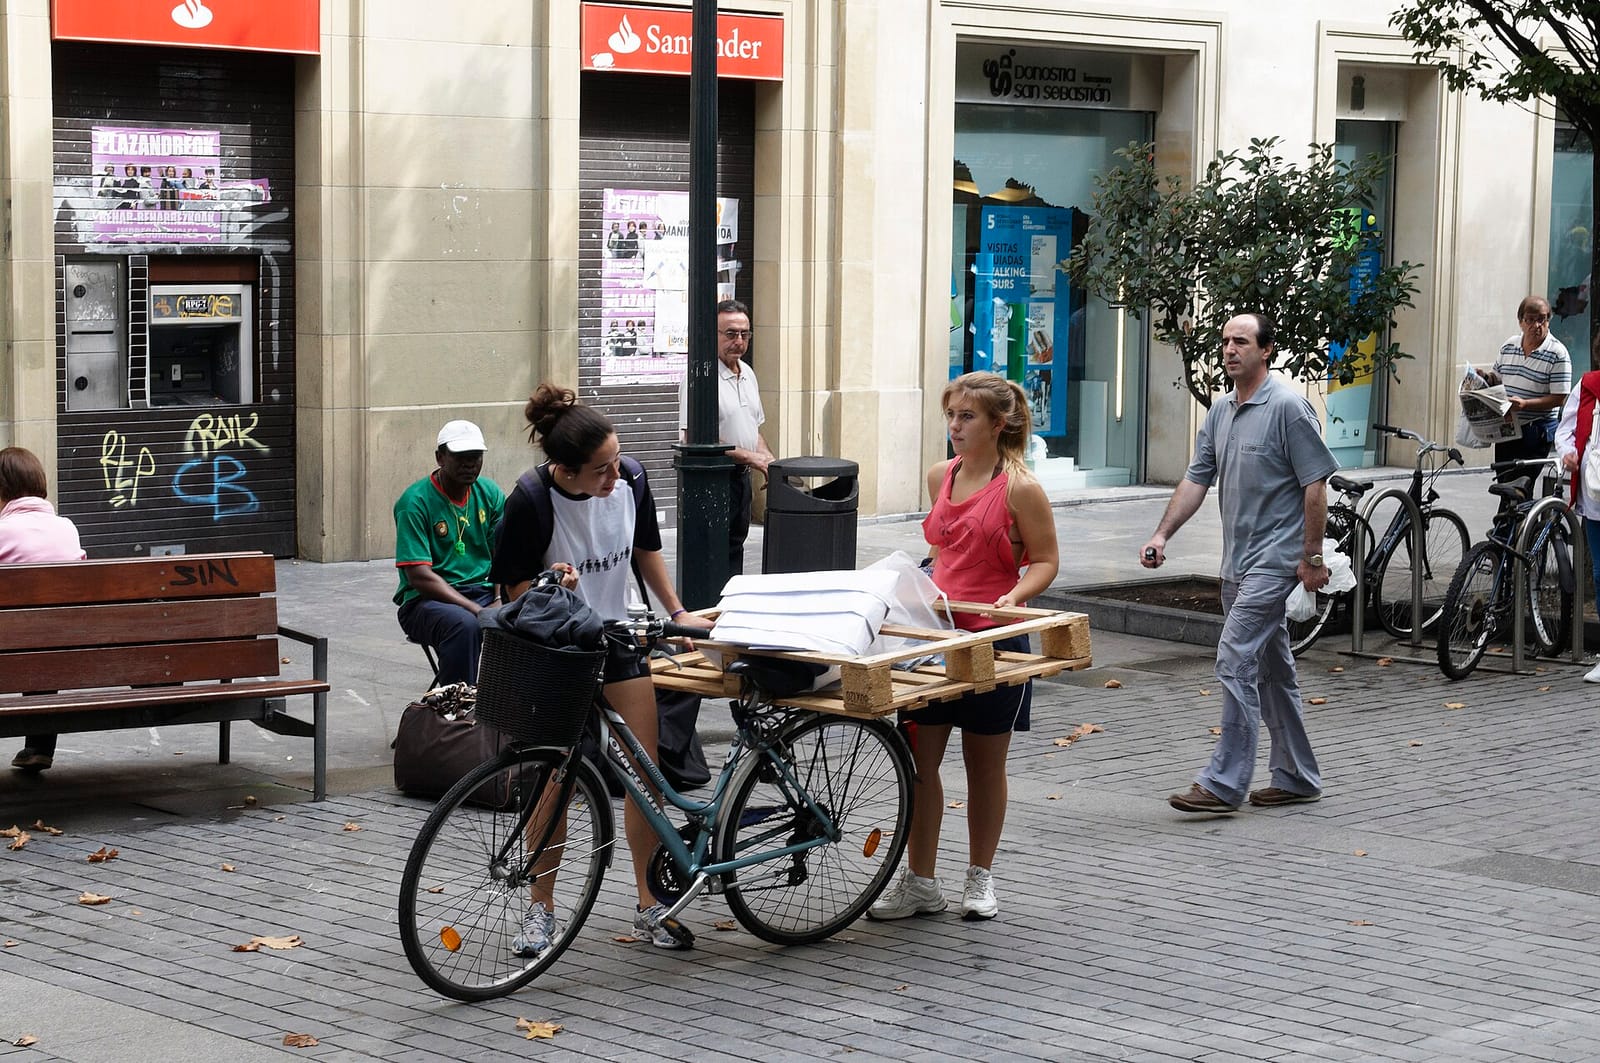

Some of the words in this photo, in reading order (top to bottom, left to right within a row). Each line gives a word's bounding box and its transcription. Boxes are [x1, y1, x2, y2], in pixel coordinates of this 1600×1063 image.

[646, 24, 762, 59] Sannder
[987, 214, 995, 229] 5
[987, 242, 1018, 253] VISITAS
[993, 254, 1023, 266] UIADAS
[992, 266, 1026, 278] ALKING
[992, 278, 1015, 290] OURS
[170, 558, 239, 587] SIN
